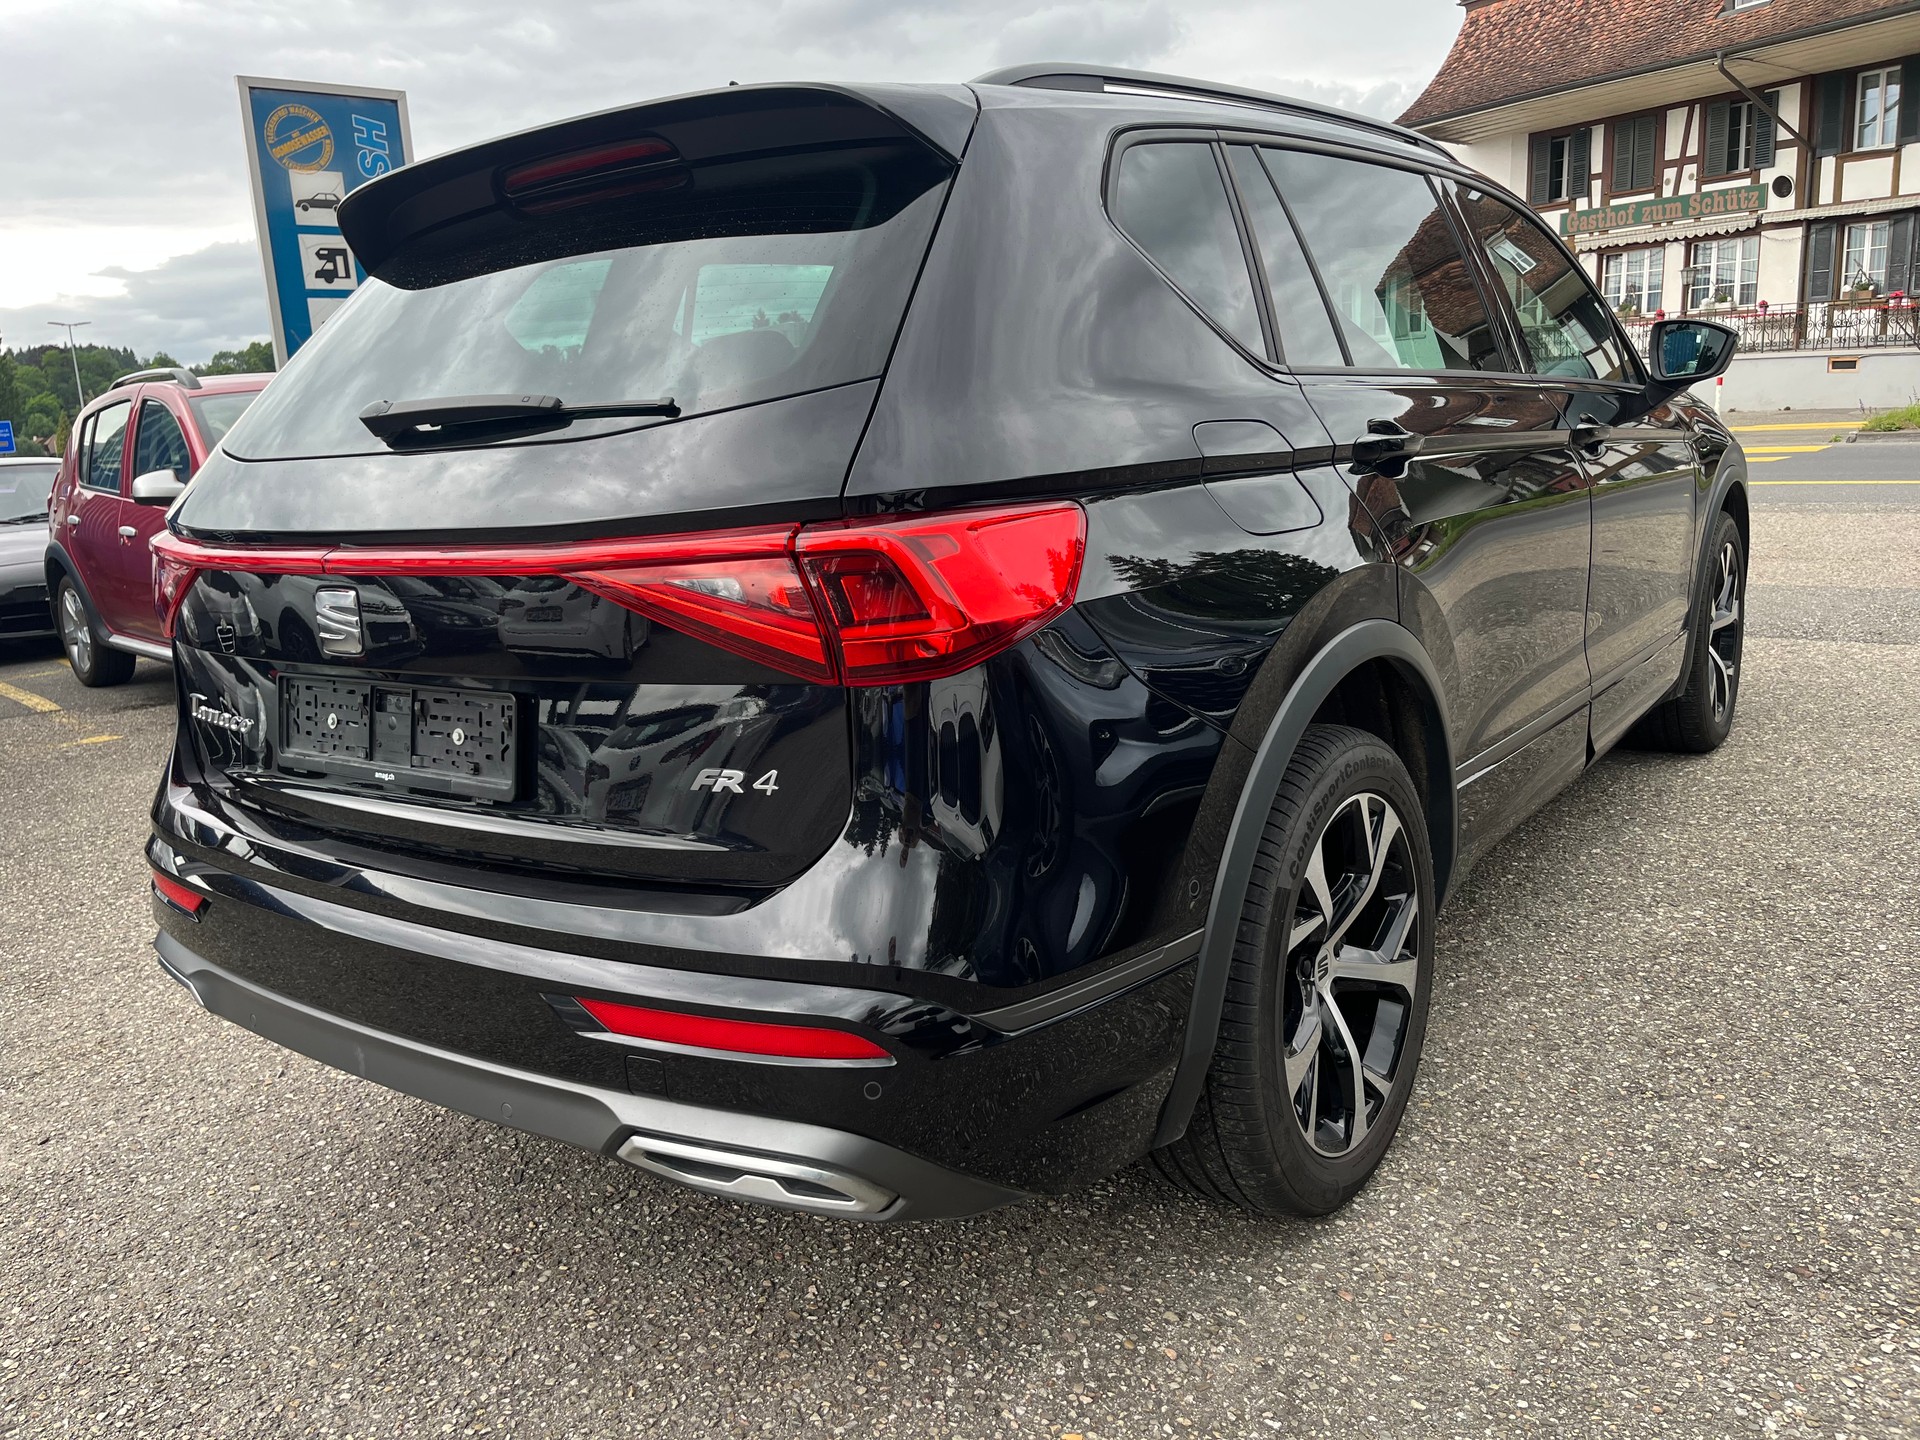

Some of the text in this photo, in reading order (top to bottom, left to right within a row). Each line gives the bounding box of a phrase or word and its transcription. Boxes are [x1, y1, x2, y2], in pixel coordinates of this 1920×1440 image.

[1566, 188, 1759, 233] Gasthof zum Schütz
[690, 768, 779, 796] FR 4
